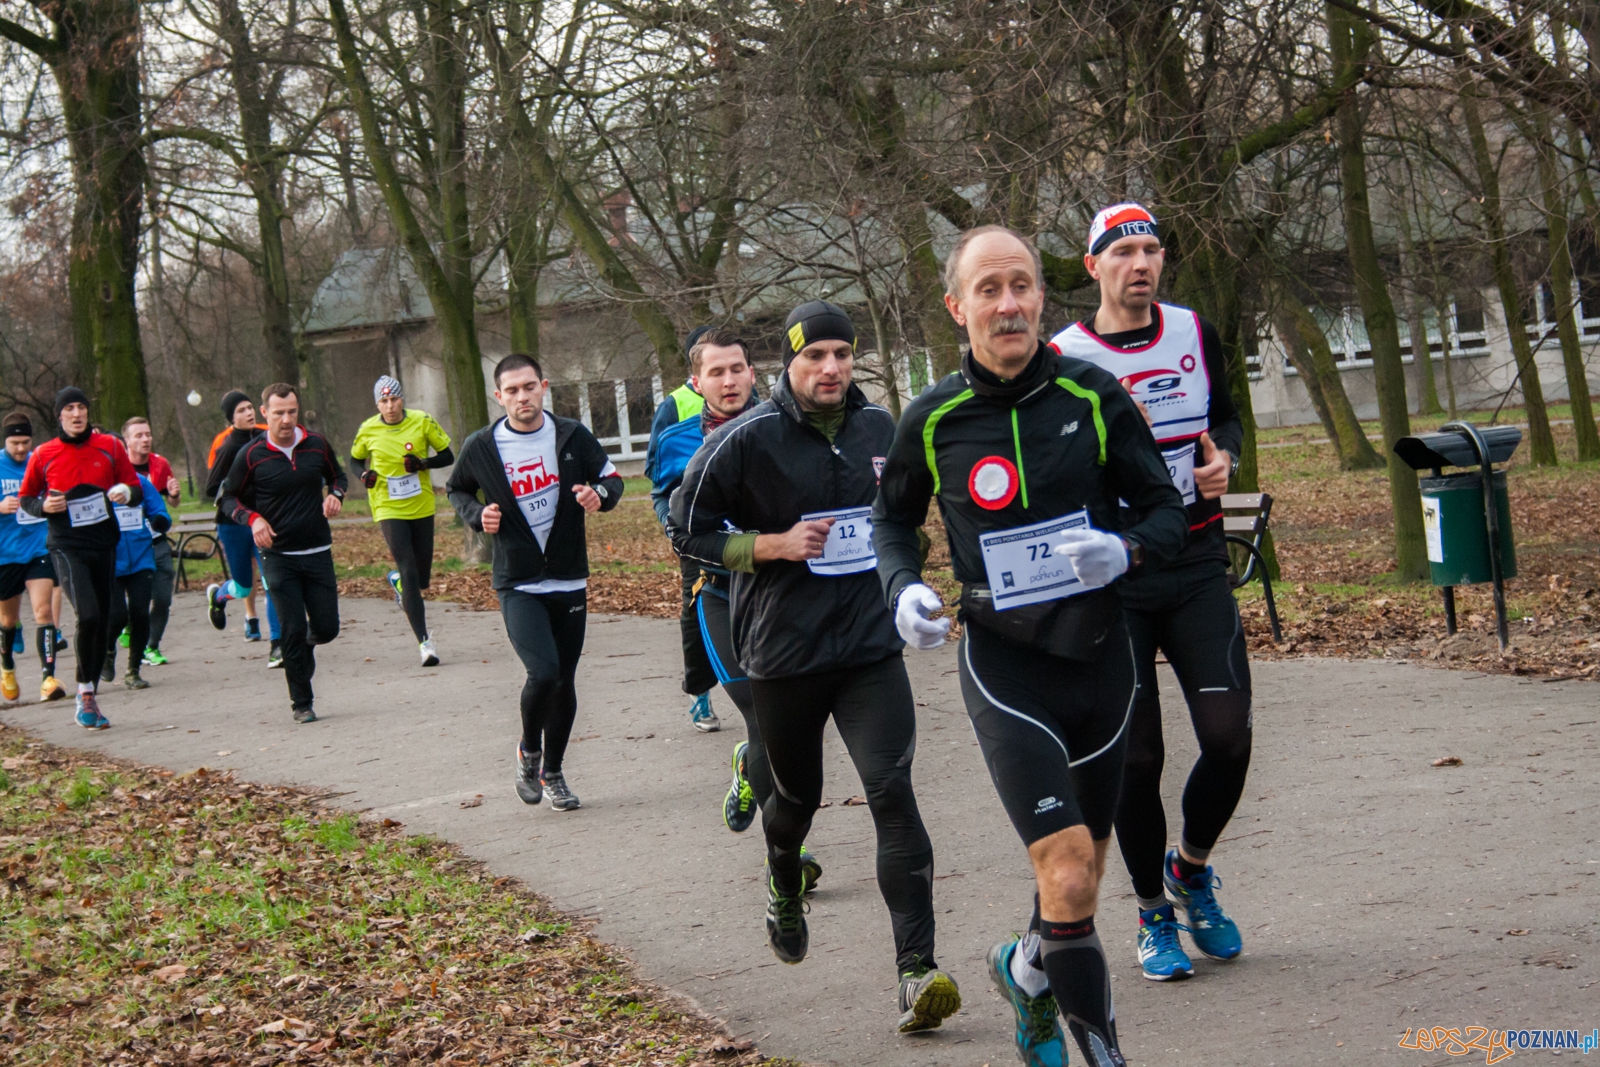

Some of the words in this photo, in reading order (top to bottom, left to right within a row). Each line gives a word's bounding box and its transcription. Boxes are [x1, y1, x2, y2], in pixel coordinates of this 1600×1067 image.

[1117, 220, 1154, 236] TREK
[528, 498, 547, 512] 370
[839, 524, 856, 539] 12
[1002, 532, 1035, 542] POWSTANIA
[1034, 519, 1083, 535] WIELKOPOLSKIEGO
[837, 543, 862, 557] parkrun
[1026, 542, 1052, 561] 72
[1029, 565, 1064, 584] parkrun
